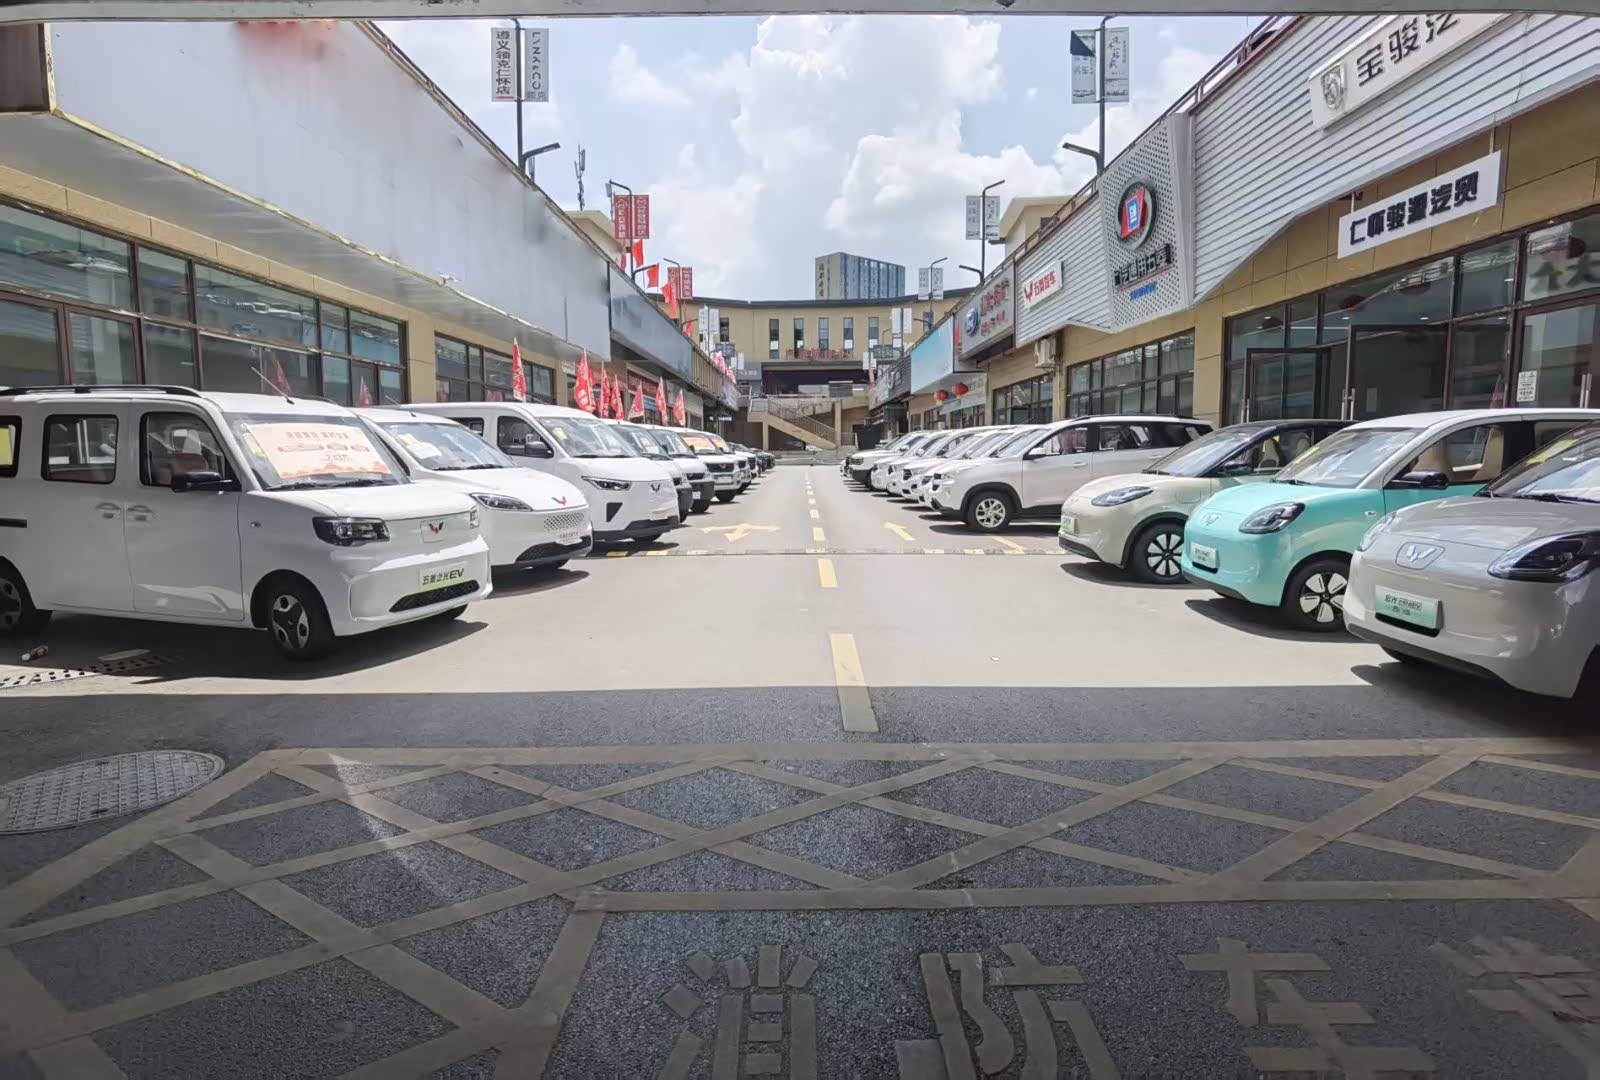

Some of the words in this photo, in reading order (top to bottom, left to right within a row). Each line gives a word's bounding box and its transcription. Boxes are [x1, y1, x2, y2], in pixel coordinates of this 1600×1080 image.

[496, 30, 511, 95] 遵义领克仁怀店
